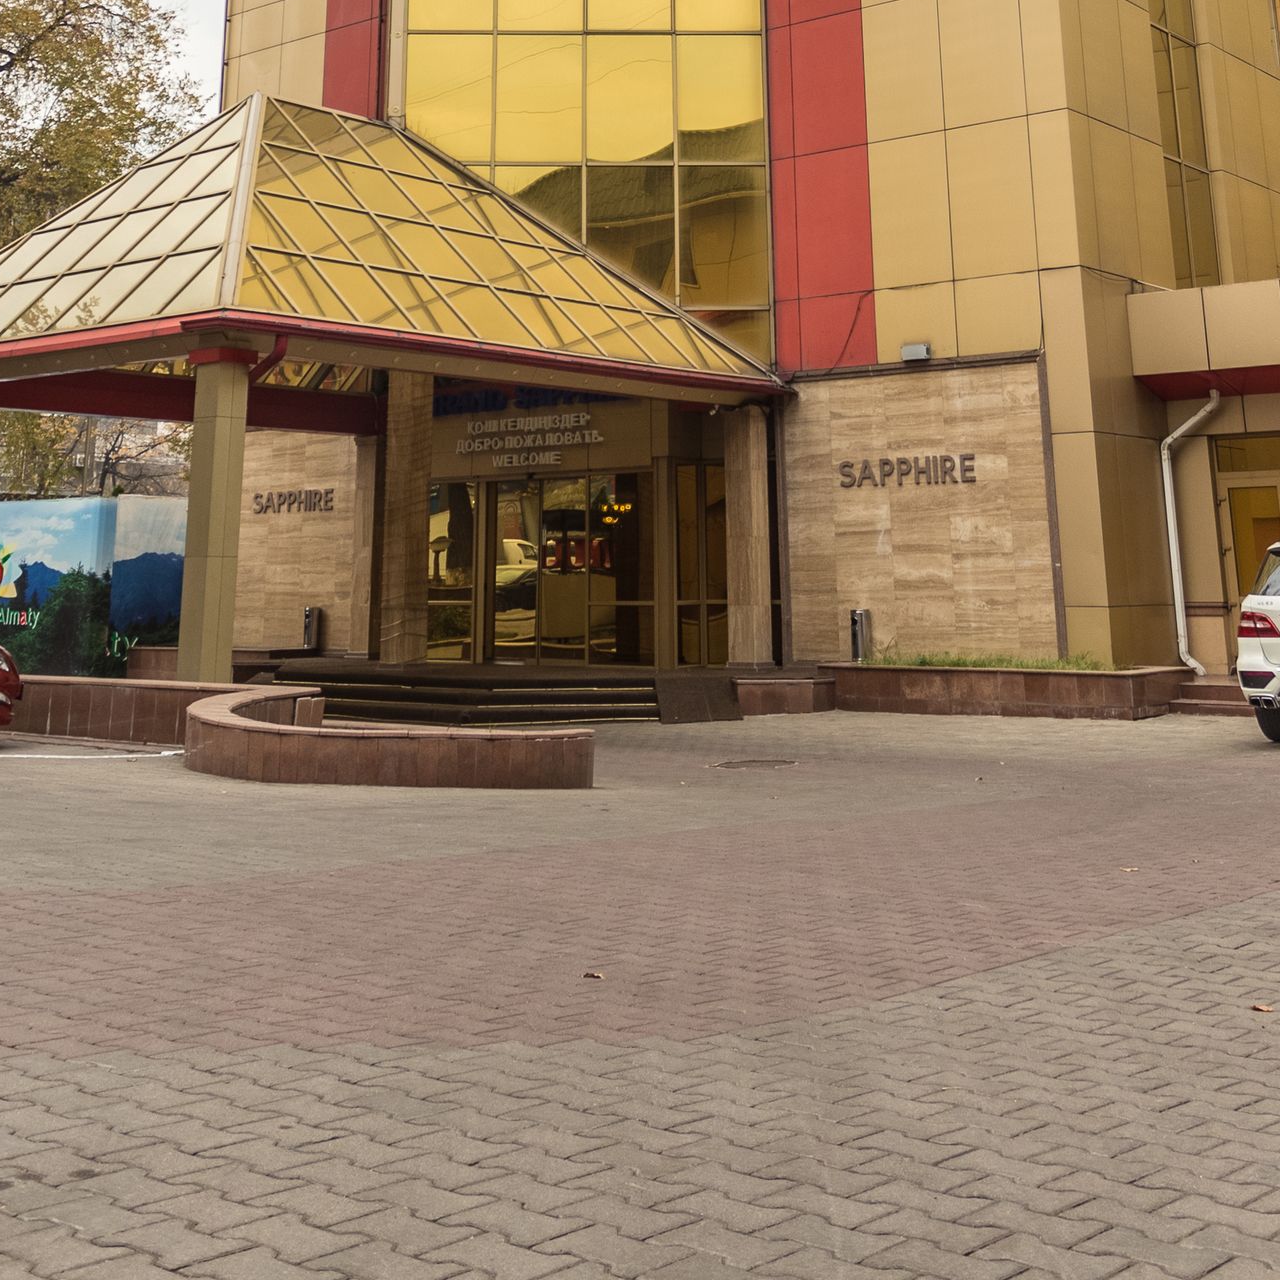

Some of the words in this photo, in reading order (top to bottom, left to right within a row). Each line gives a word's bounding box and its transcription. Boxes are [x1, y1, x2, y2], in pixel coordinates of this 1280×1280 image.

[456, 437, 502, 454] ДОБРО
[504, 430, 600, 449] ПОЖАЛОВАТЬ
[492, 451, 562, 468] WELCOME
[838, 453, 977, 489] SAPPHIRE
[252, 488, 335, 515] SAPPHIRE
